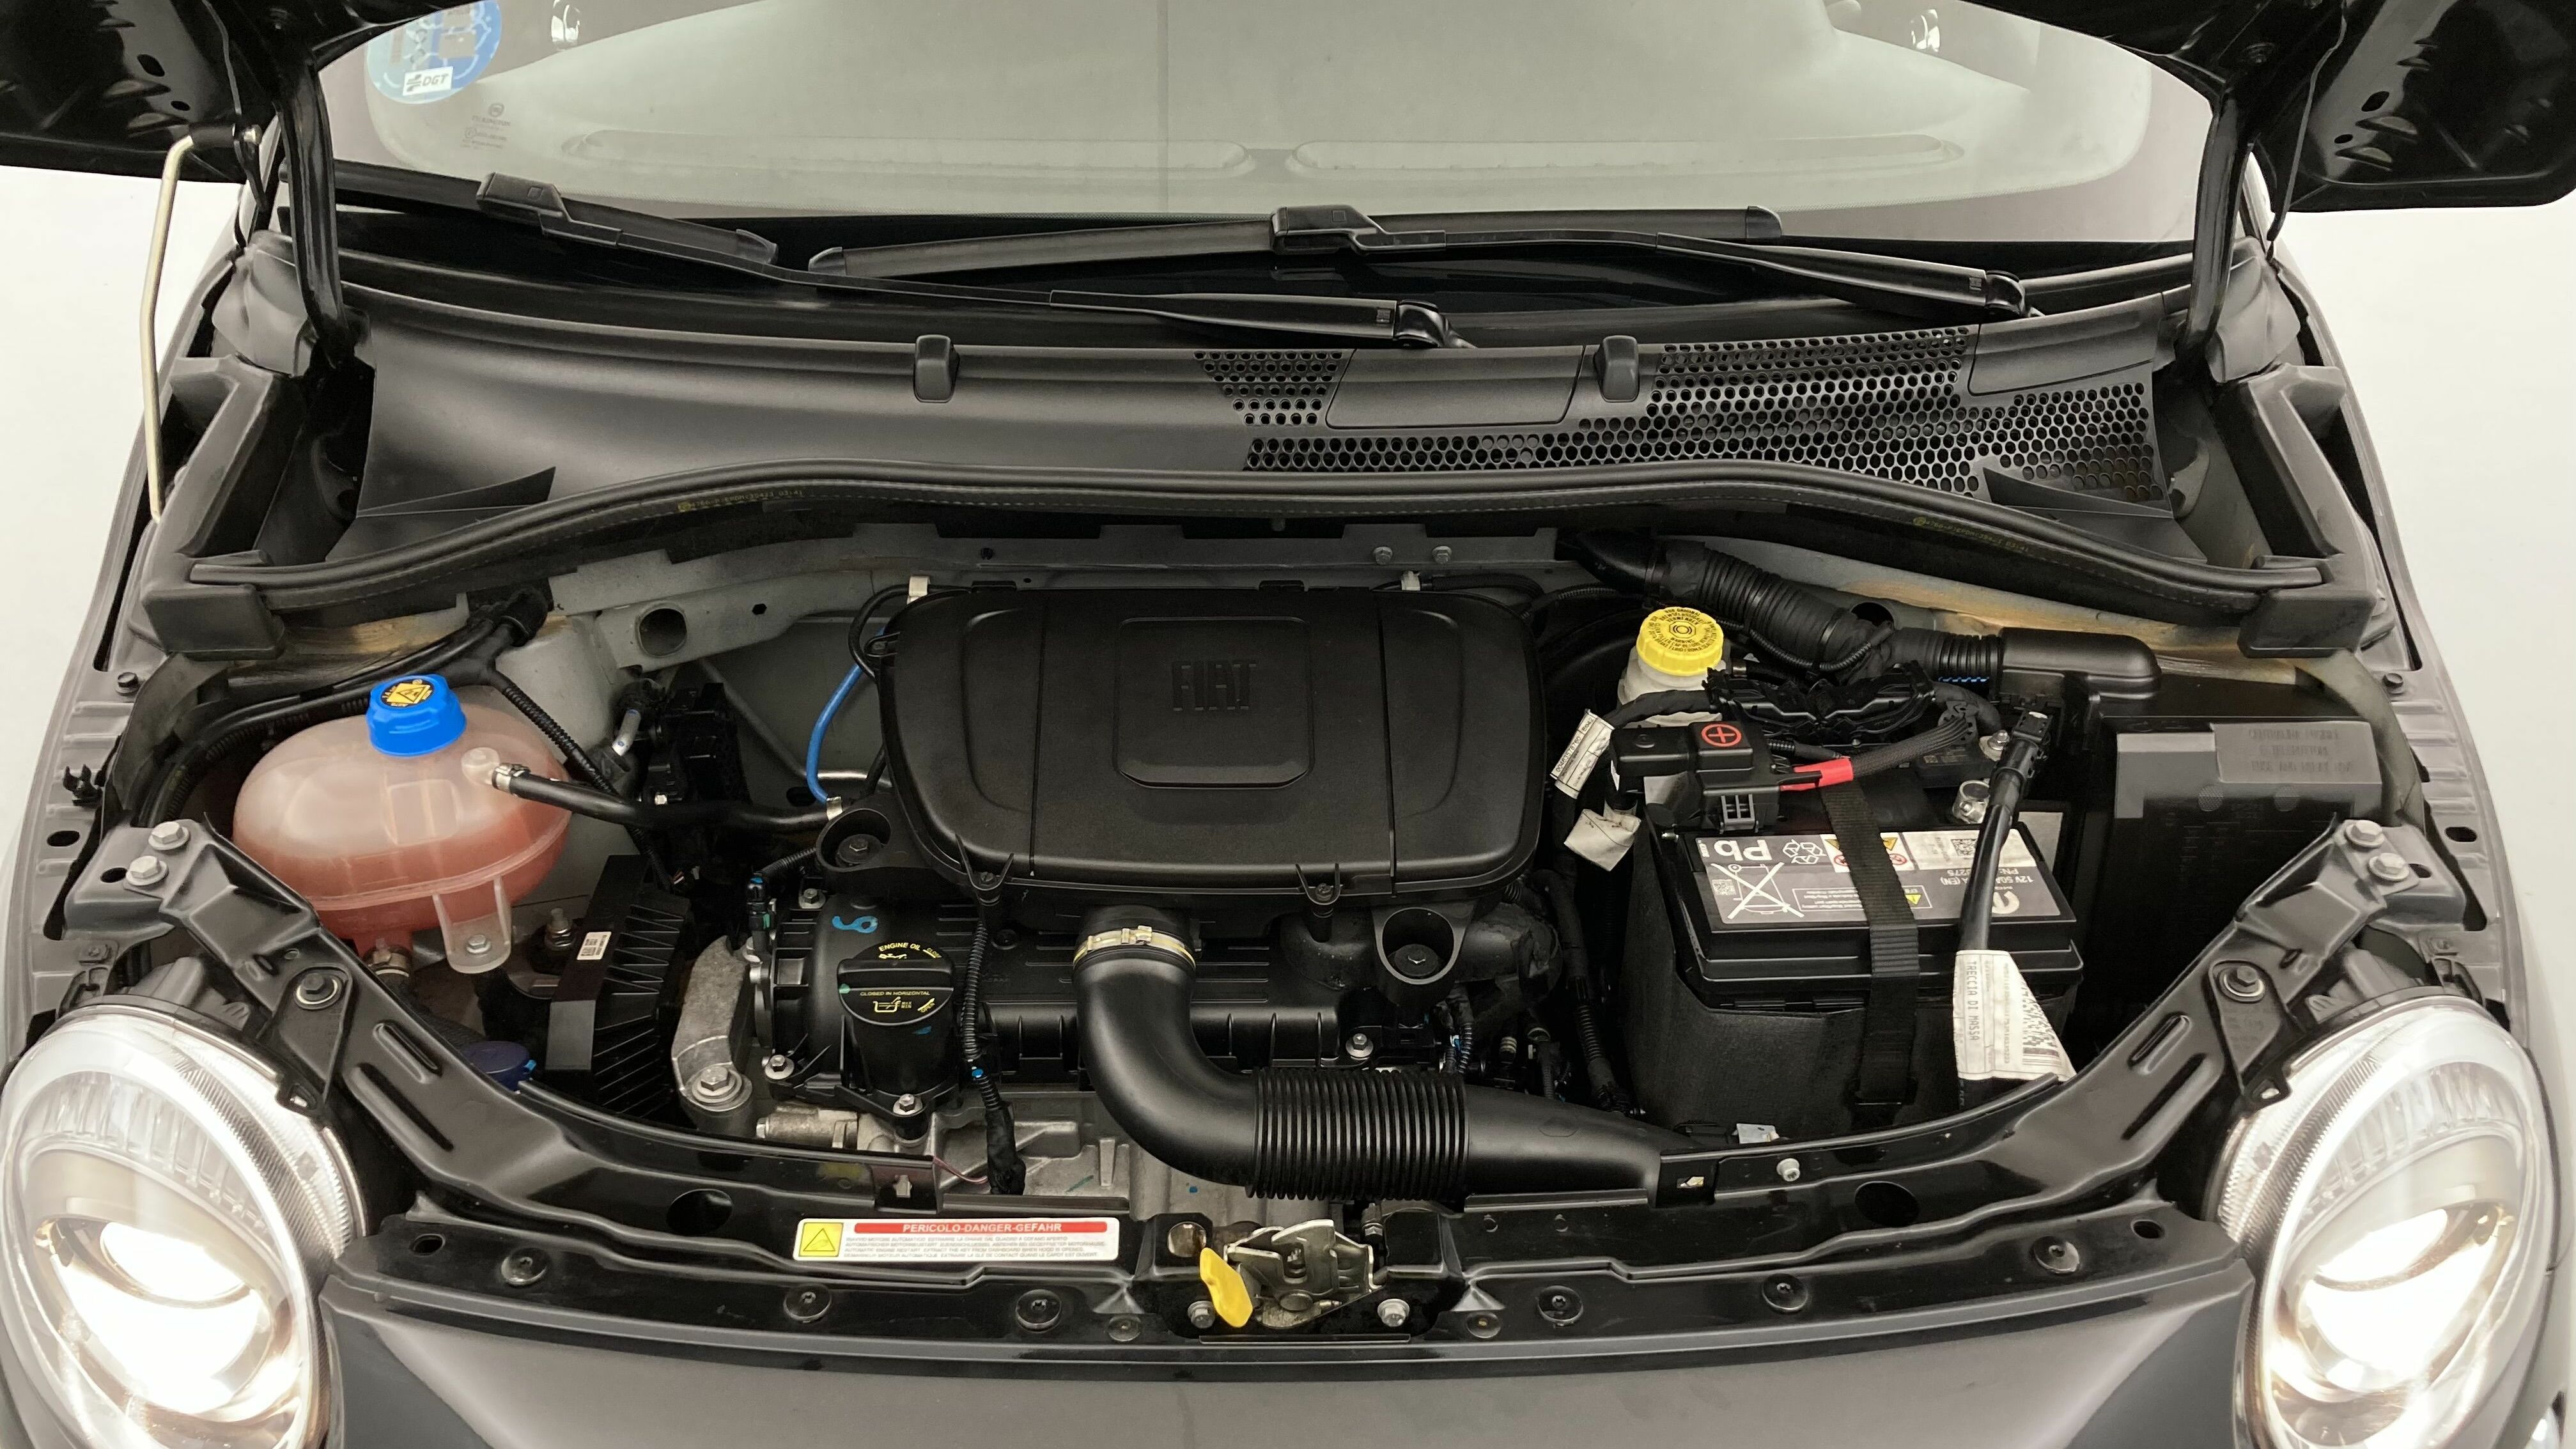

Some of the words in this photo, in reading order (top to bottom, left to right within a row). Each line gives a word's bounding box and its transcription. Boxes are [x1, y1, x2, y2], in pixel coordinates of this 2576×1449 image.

[422, 74, 449, 87] DGT
[1172, 660, 1257, 711] FIAT
[1714, 839, 1773, 861] Pb
[1940, 876, 1960, 885] (EN)
[2015, 875, 2035, 883] 12V
[878, 942, 908, 952] ENGINE
[1966, 961, 1978, 996] TRECCIA
[1967, 1000, 1979, 1010] DI
[1968, 1015, 1980, 1041] MASSA
[903, 1223, 1062, 1233] PERICOLO-DANGER-GEFAHR
